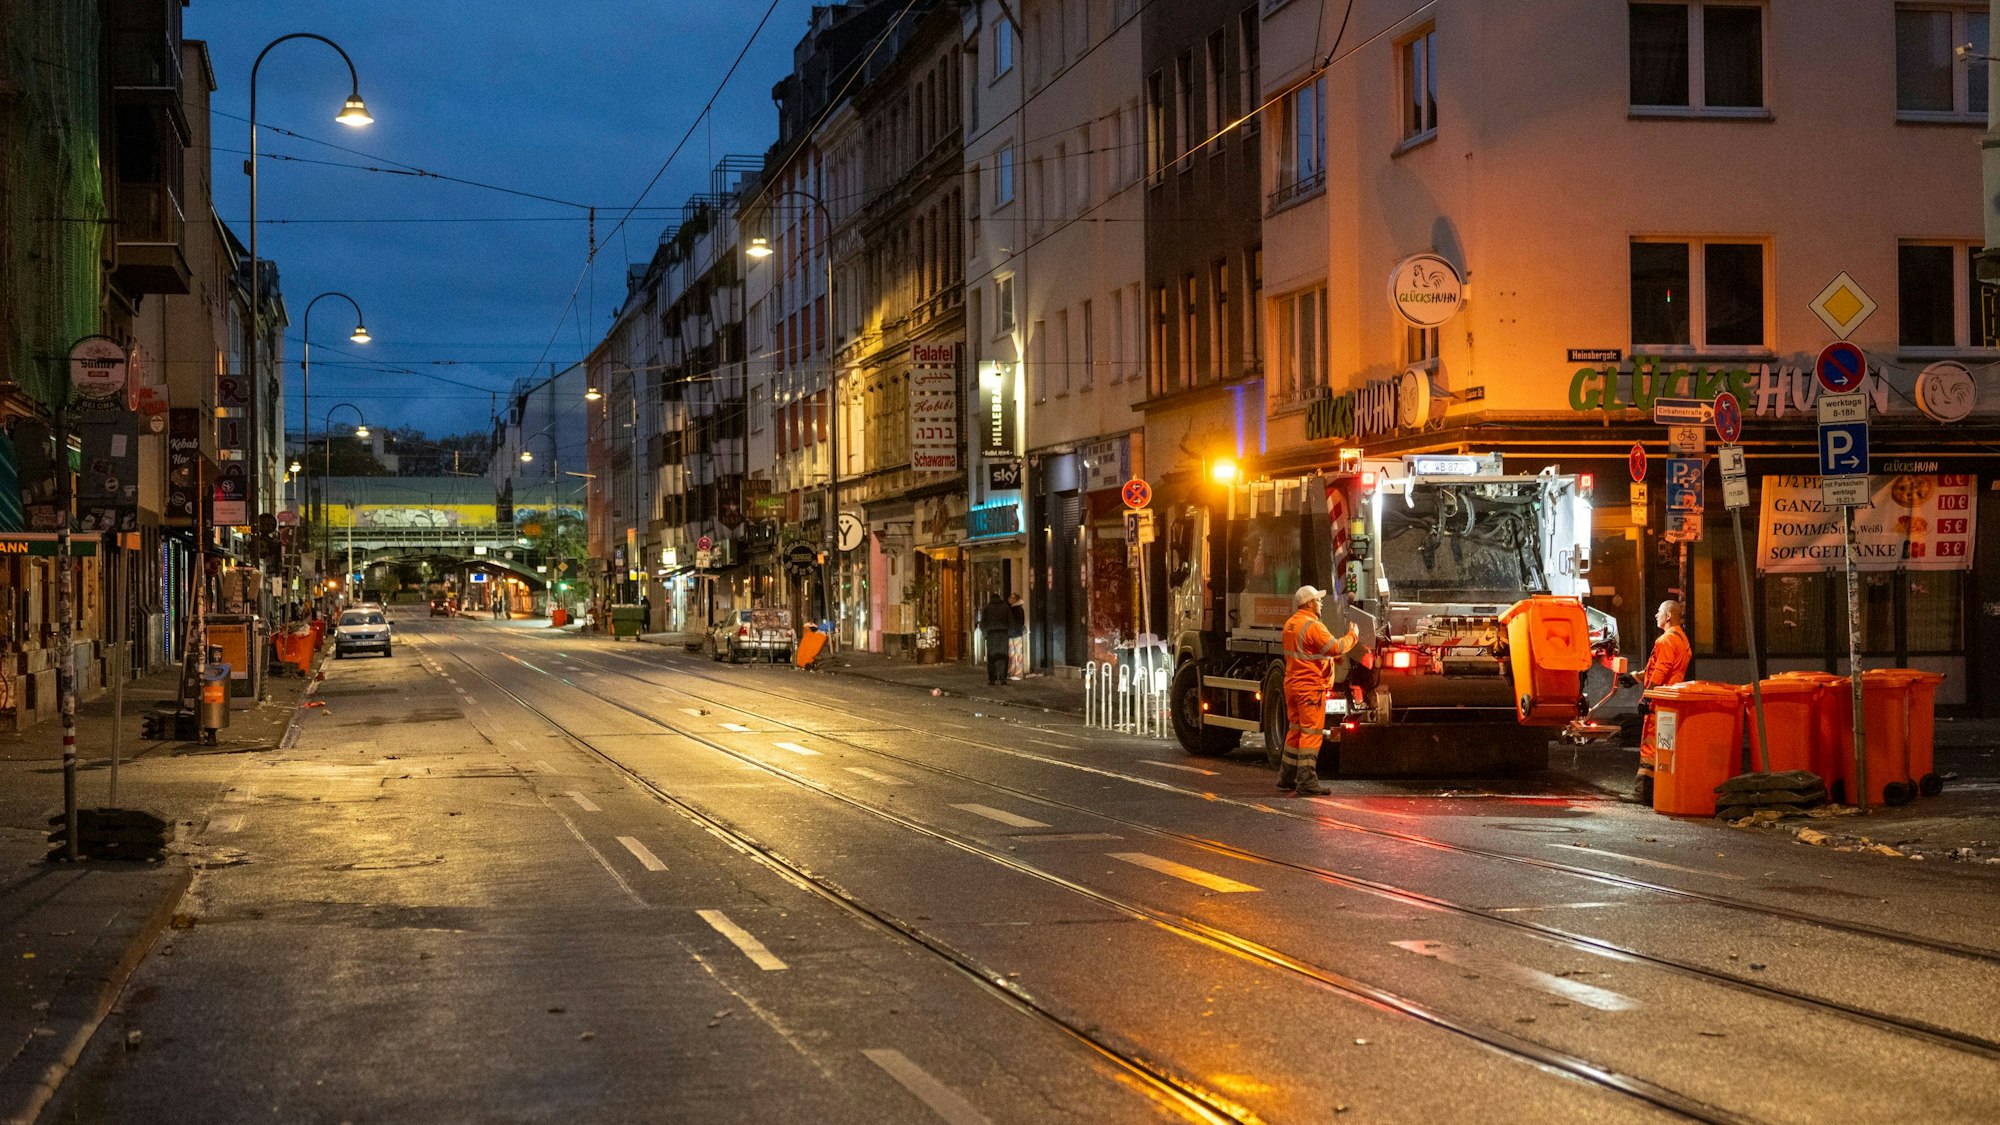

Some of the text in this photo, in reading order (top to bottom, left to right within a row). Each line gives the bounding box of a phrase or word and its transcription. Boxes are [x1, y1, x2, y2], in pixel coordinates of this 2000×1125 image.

[1400, 291, 1456, 303] GLÜCKSHUHN
[914, 346, 953, 361] Falafel
[1572, 350, 1617, 361] Heinsbergstr.
[915, 373, 953, 386] حبيبي
[1569, 355, 1889, 418] GLÜCKSHUN
[914, 398, 954, 413] Habibi
[992, 371, 1002, 446] HILLEBRA
[1826, 399, 1862, 408] werktags
[1658, 407, 1702, 416] Einbahnstraße
[917, 428, 954, 439] ברכה
[170, 438, 199, 449] Kebab
[1827, 431, 1853, 470] P
[914, 452, 956, 468] Schawarma
[1884, 460, 1938, 472] GLÜCKSHUHN
[993, 468, 1018, 484] sky
[1673, 463, 1688, 484] P
[1944, 475, 1952, 487] 6
[1942, 496, 1957, 508] 10
[1958, 496, 1966, 508] €
[1944, 520, 1952, 532] 5
[1955, 520, 1963, 532] €
[1942, 543, 1951, 555] 3
[1953, 543, 1961, 555] €
